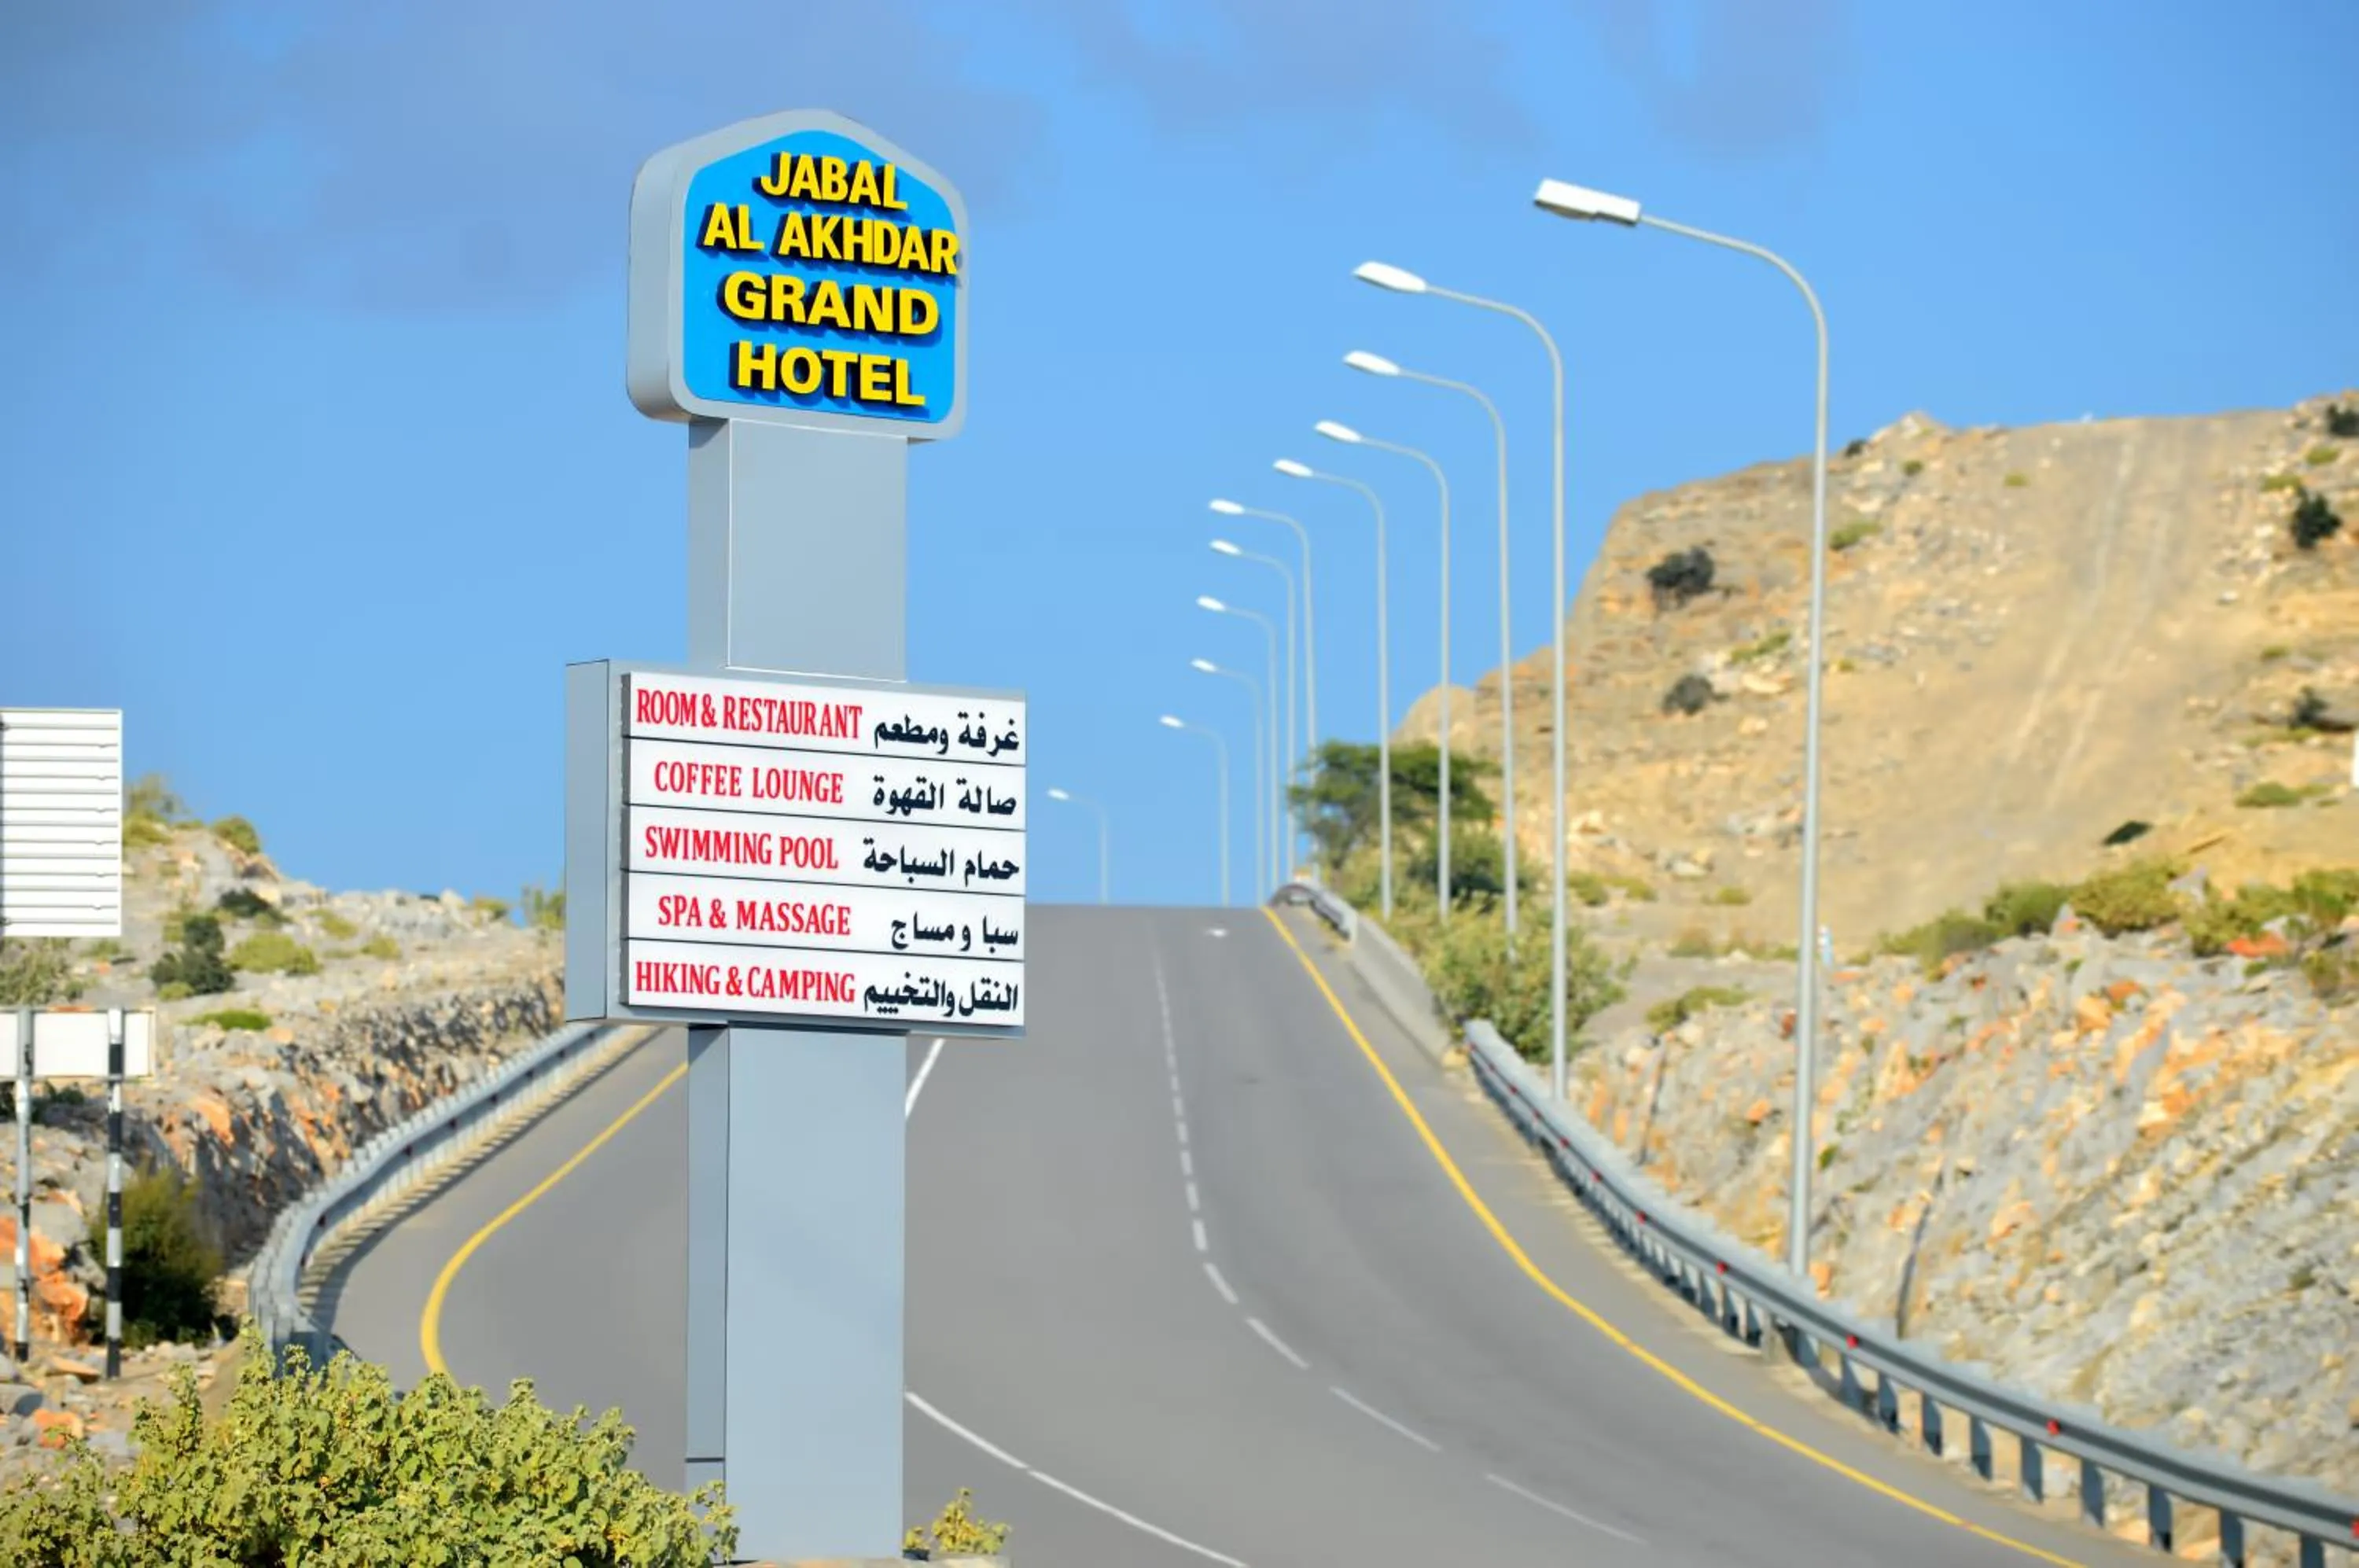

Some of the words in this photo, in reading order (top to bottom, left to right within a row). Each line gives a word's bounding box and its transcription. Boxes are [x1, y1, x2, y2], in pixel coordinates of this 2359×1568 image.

[760, 151, 908, 210] JABAL
[703, 202, 765, 250] AL
[778, 212, 959, 275] AKHDAR
[723, 271, 939, 335] GRAND
[737, 340, 926, 406] HOTEL
[636, 689, 697, 727] ROOM
[701, 694, 717, 728] &
[723, 695, 863, 739] RESTAURANT
[874, 713, 949, 755] ومطعم
[957, 711, 1020, 757] غرفة
[654, 760, 742, 797] COFFEE
[753, 767, 844, 804] LOUNGE
[873, 775, 945, 816] القهوة
[956, 778, 1018, 815] صالة
[645, 826, 772, 865] SWIMMING
[779, 836, 839, 869] POOL
[863, 837, 955, 885] السباحة
[964, 849, 1020, 888] حمام
[657, 894, 702, 928] SPA
[708, 898, 727, 929] &
[736, 900, 852, 936] MASSAGE
[982, 915, 1019, 954] سبا
[635, 960, 720, 996] HIKING
[726, 966, 743, 997] &
[747, 966, 856, 1003] CAMPING
